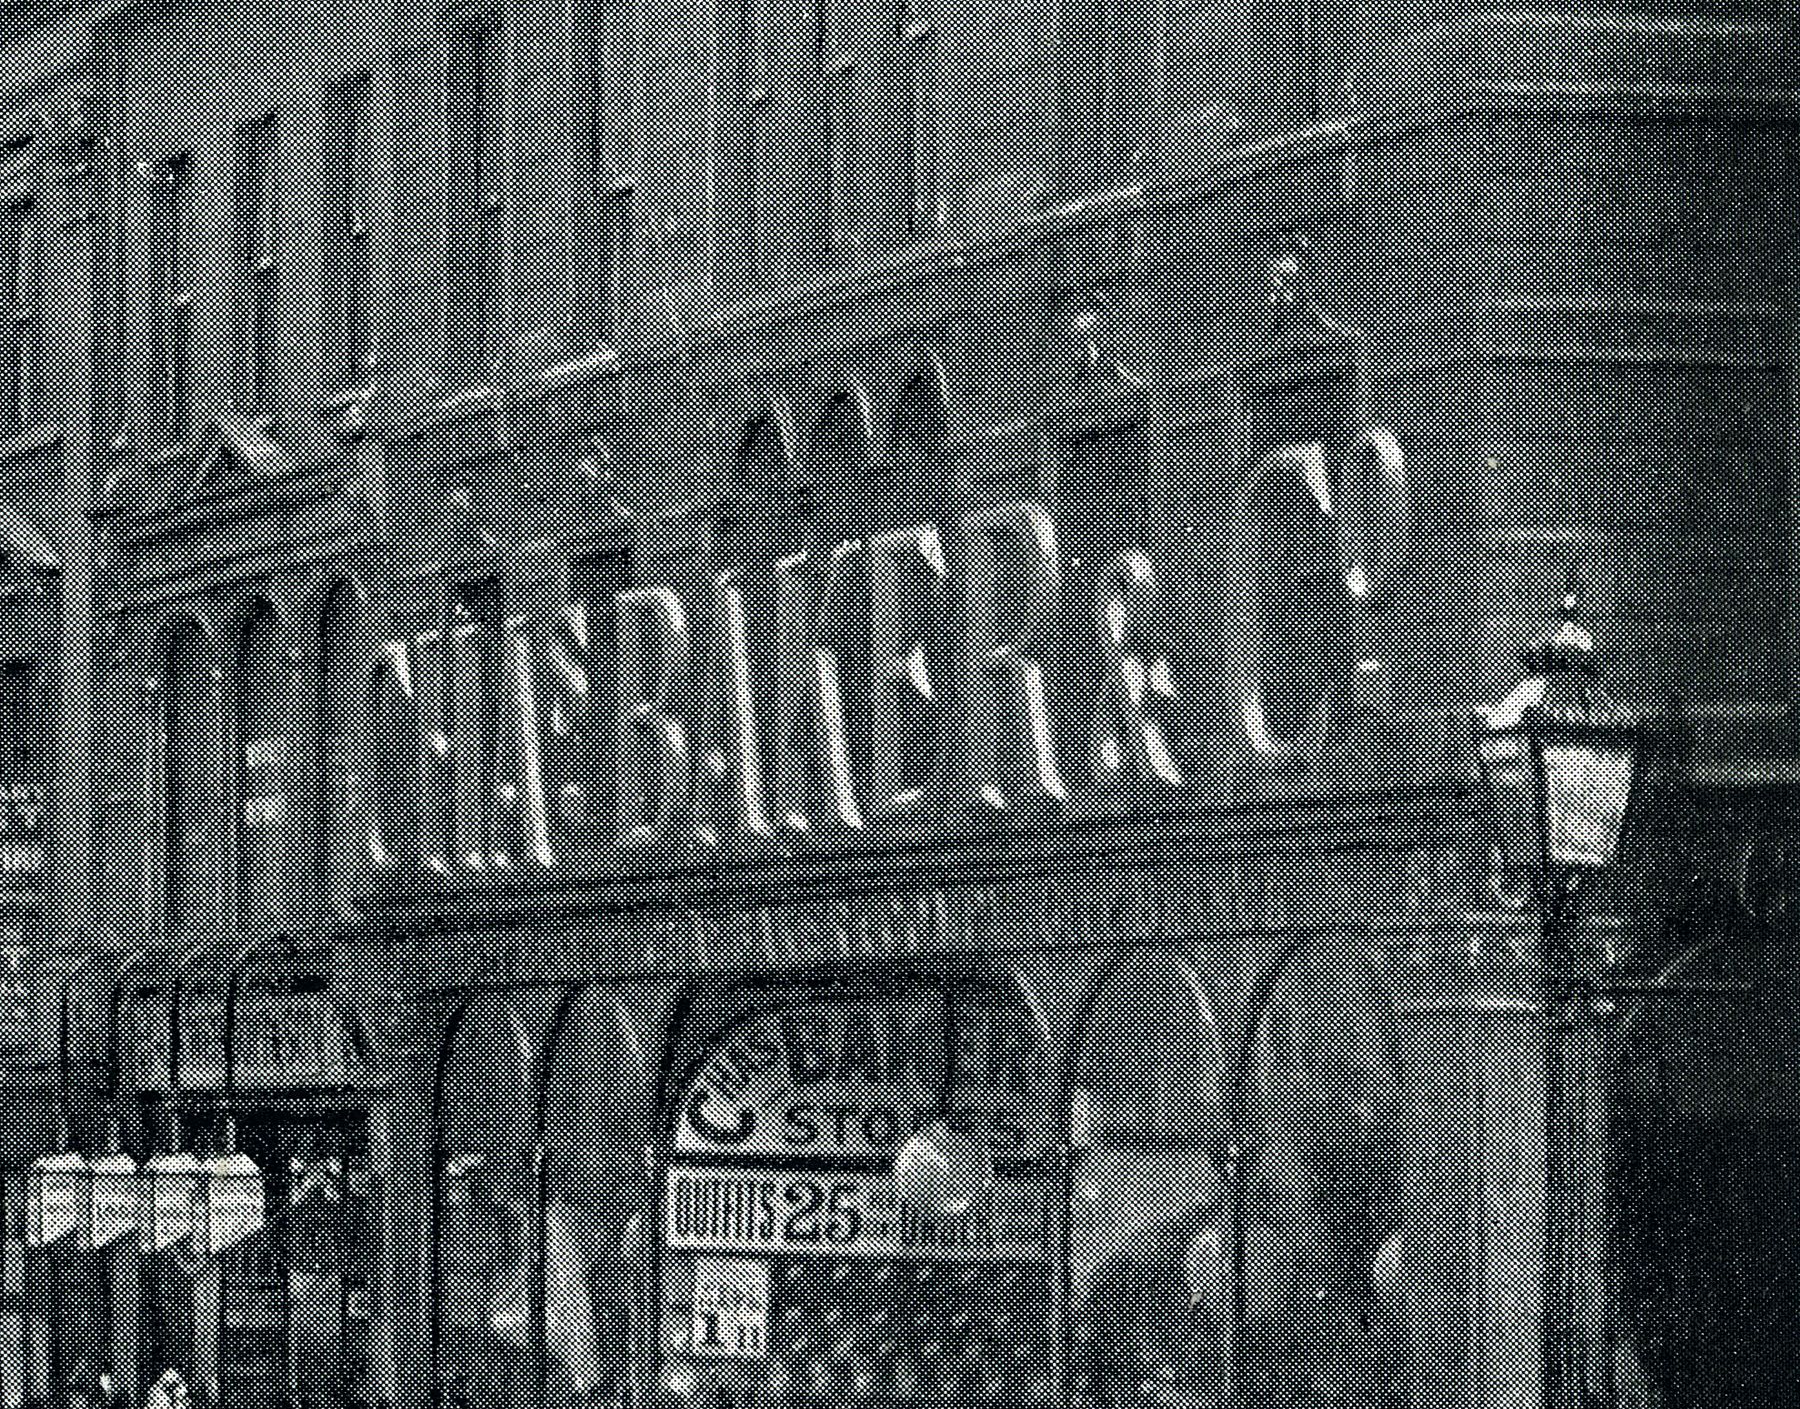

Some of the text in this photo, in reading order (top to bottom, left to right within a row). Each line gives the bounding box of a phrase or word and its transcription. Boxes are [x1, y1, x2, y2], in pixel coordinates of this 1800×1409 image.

[613, 495, 1074, 852] BAKER
[1090, 544, 1186, 790] &
[687, 1009, 1035, 1145] CHAS BAKER
[675, 1175, 776, 1242] OUTFITS
[783, 1179, 863, 1244] 25
